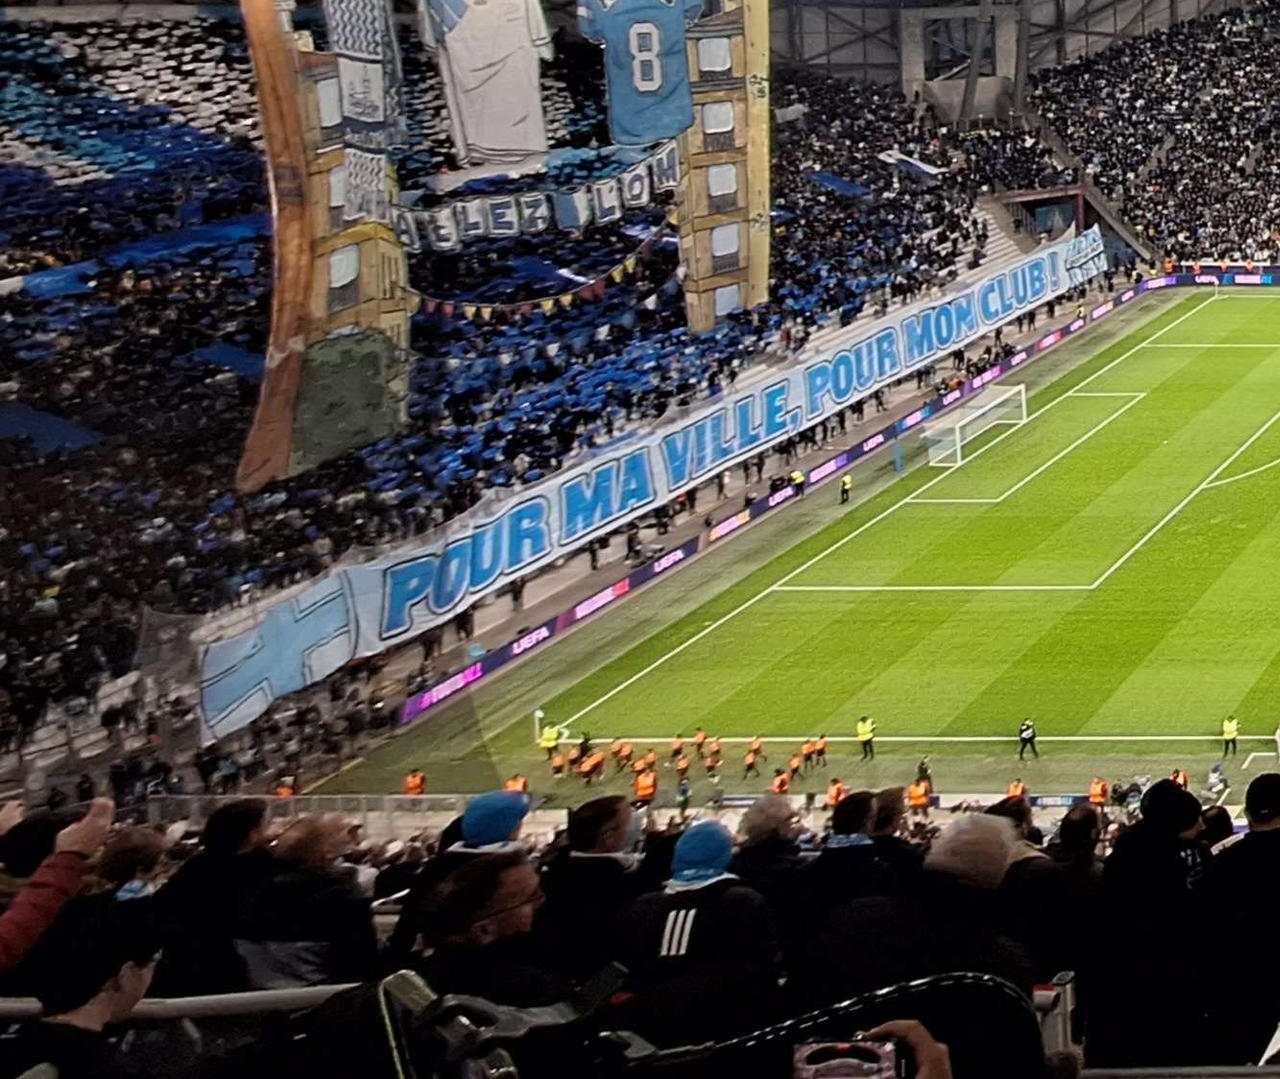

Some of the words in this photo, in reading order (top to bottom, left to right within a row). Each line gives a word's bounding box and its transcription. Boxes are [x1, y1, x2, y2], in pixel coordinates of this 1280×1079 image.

[629, 22, 663, 92] 8
[380, 494, 551, 639] POUR
[559, 449, 655, 546] MA
[665, 377, 802, 491] VILLE,
[805, 326, 901, 421] POUR
[902, 294, 976, 369] MON
[979, 258, 1048, 325] CLUB
[511, 626, 550, 655] UEFA
